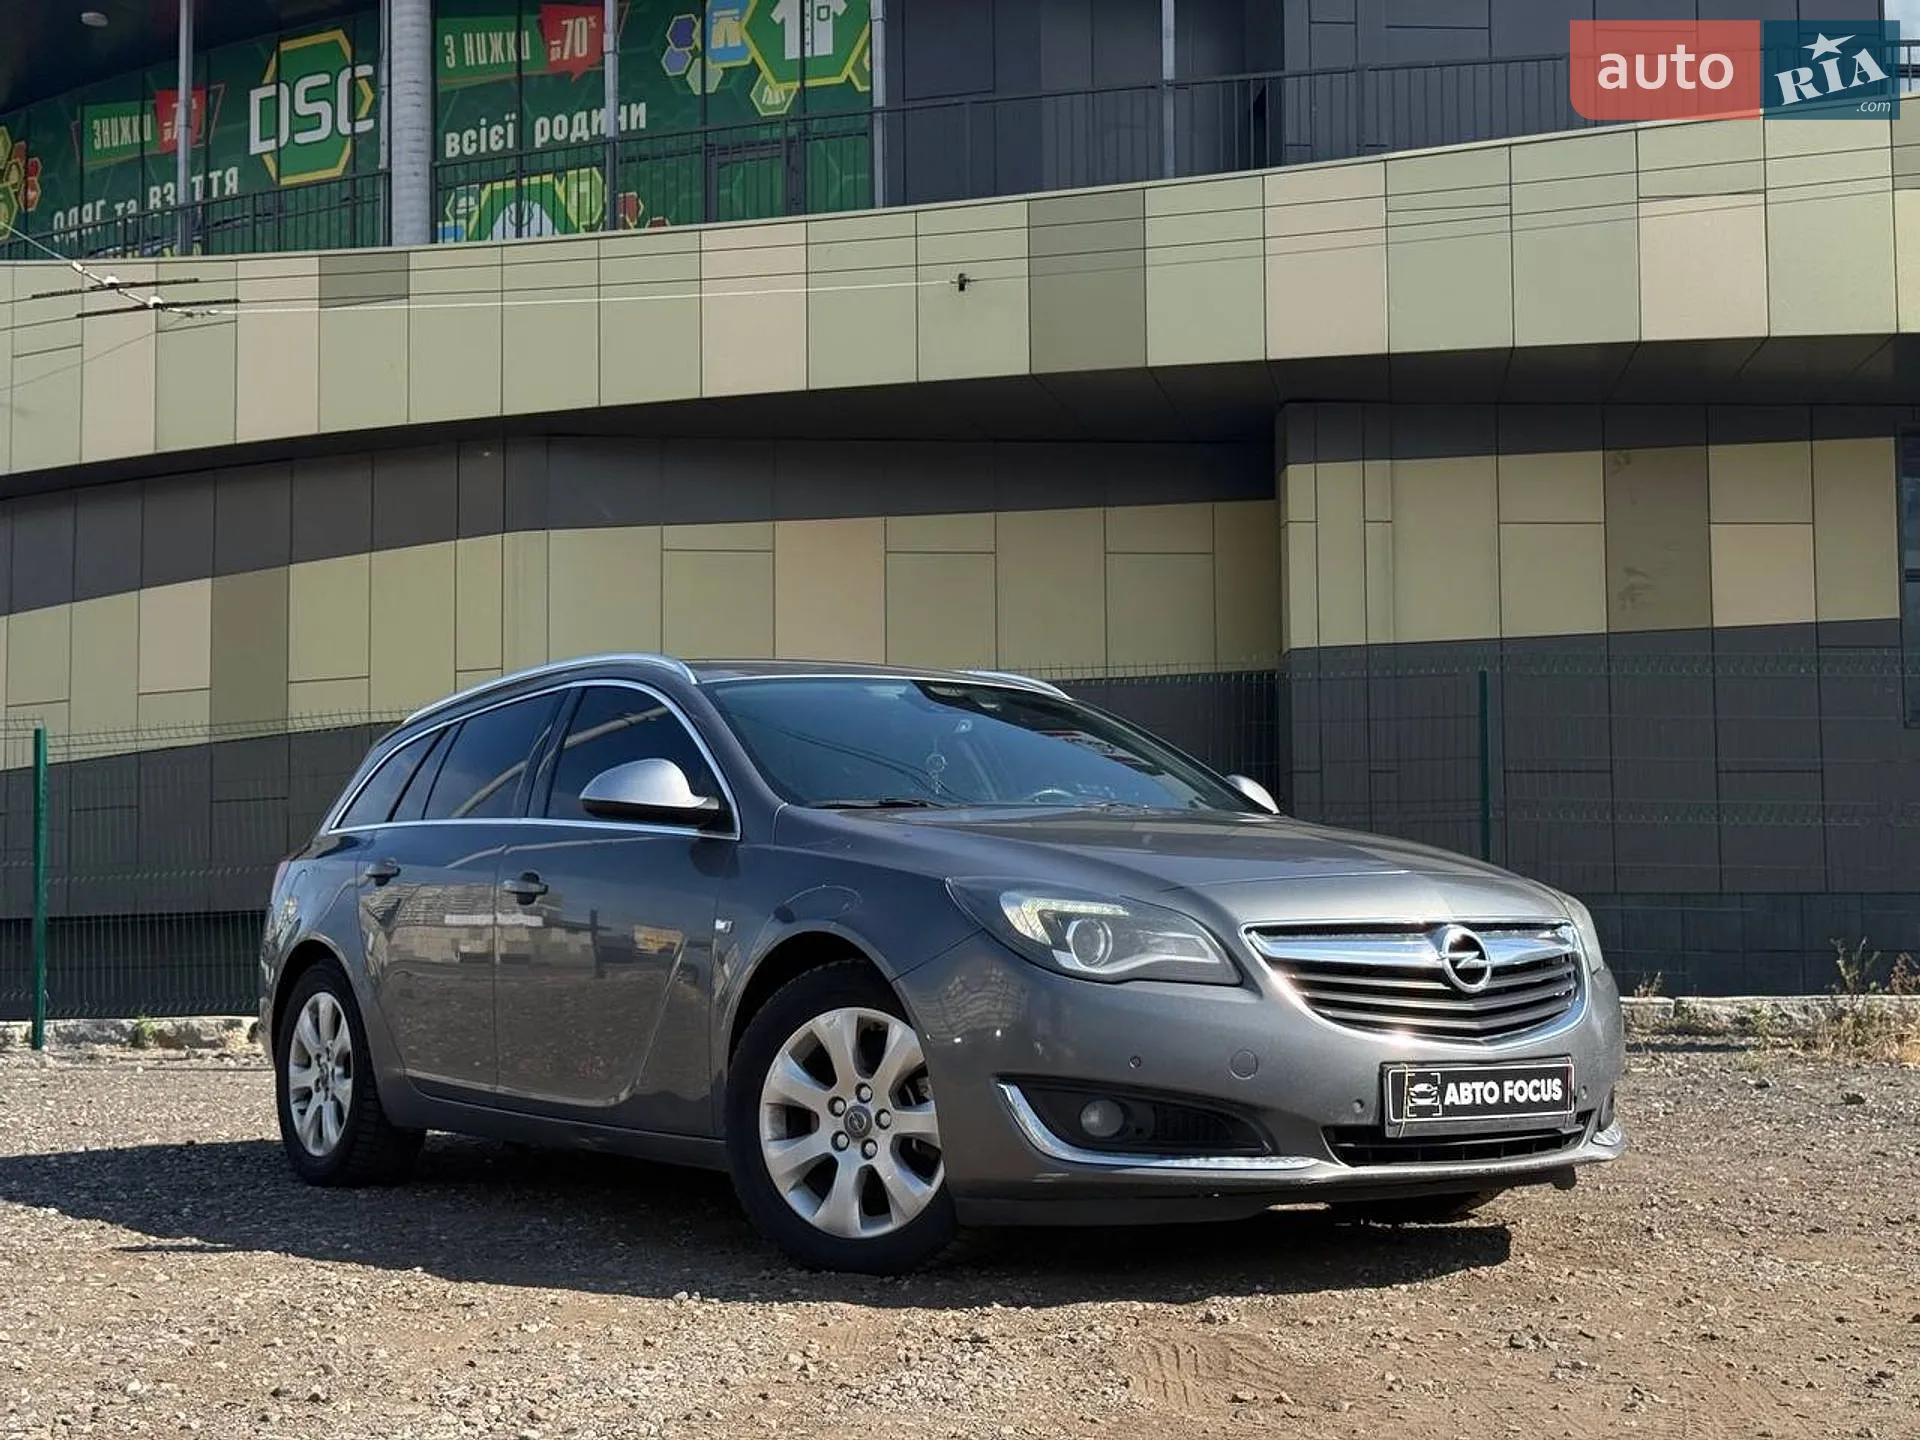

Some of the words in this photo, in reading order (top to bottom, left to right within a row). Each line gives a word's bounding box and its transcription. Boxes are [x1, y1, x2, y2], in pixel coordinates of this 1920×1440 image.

[92, 114, 152, 150] ЗНИЖКИ
[249, 64, 374, 155] DSC
[445, 112, 517, 158] всієї
[534, 102, 647, 149] родини
[149, 167, 239, 217] ВЗТТЯ
[1444, 1080, 1500, 1106] АВТО
[1503, 1078, 1563, 1104] FOCUS
